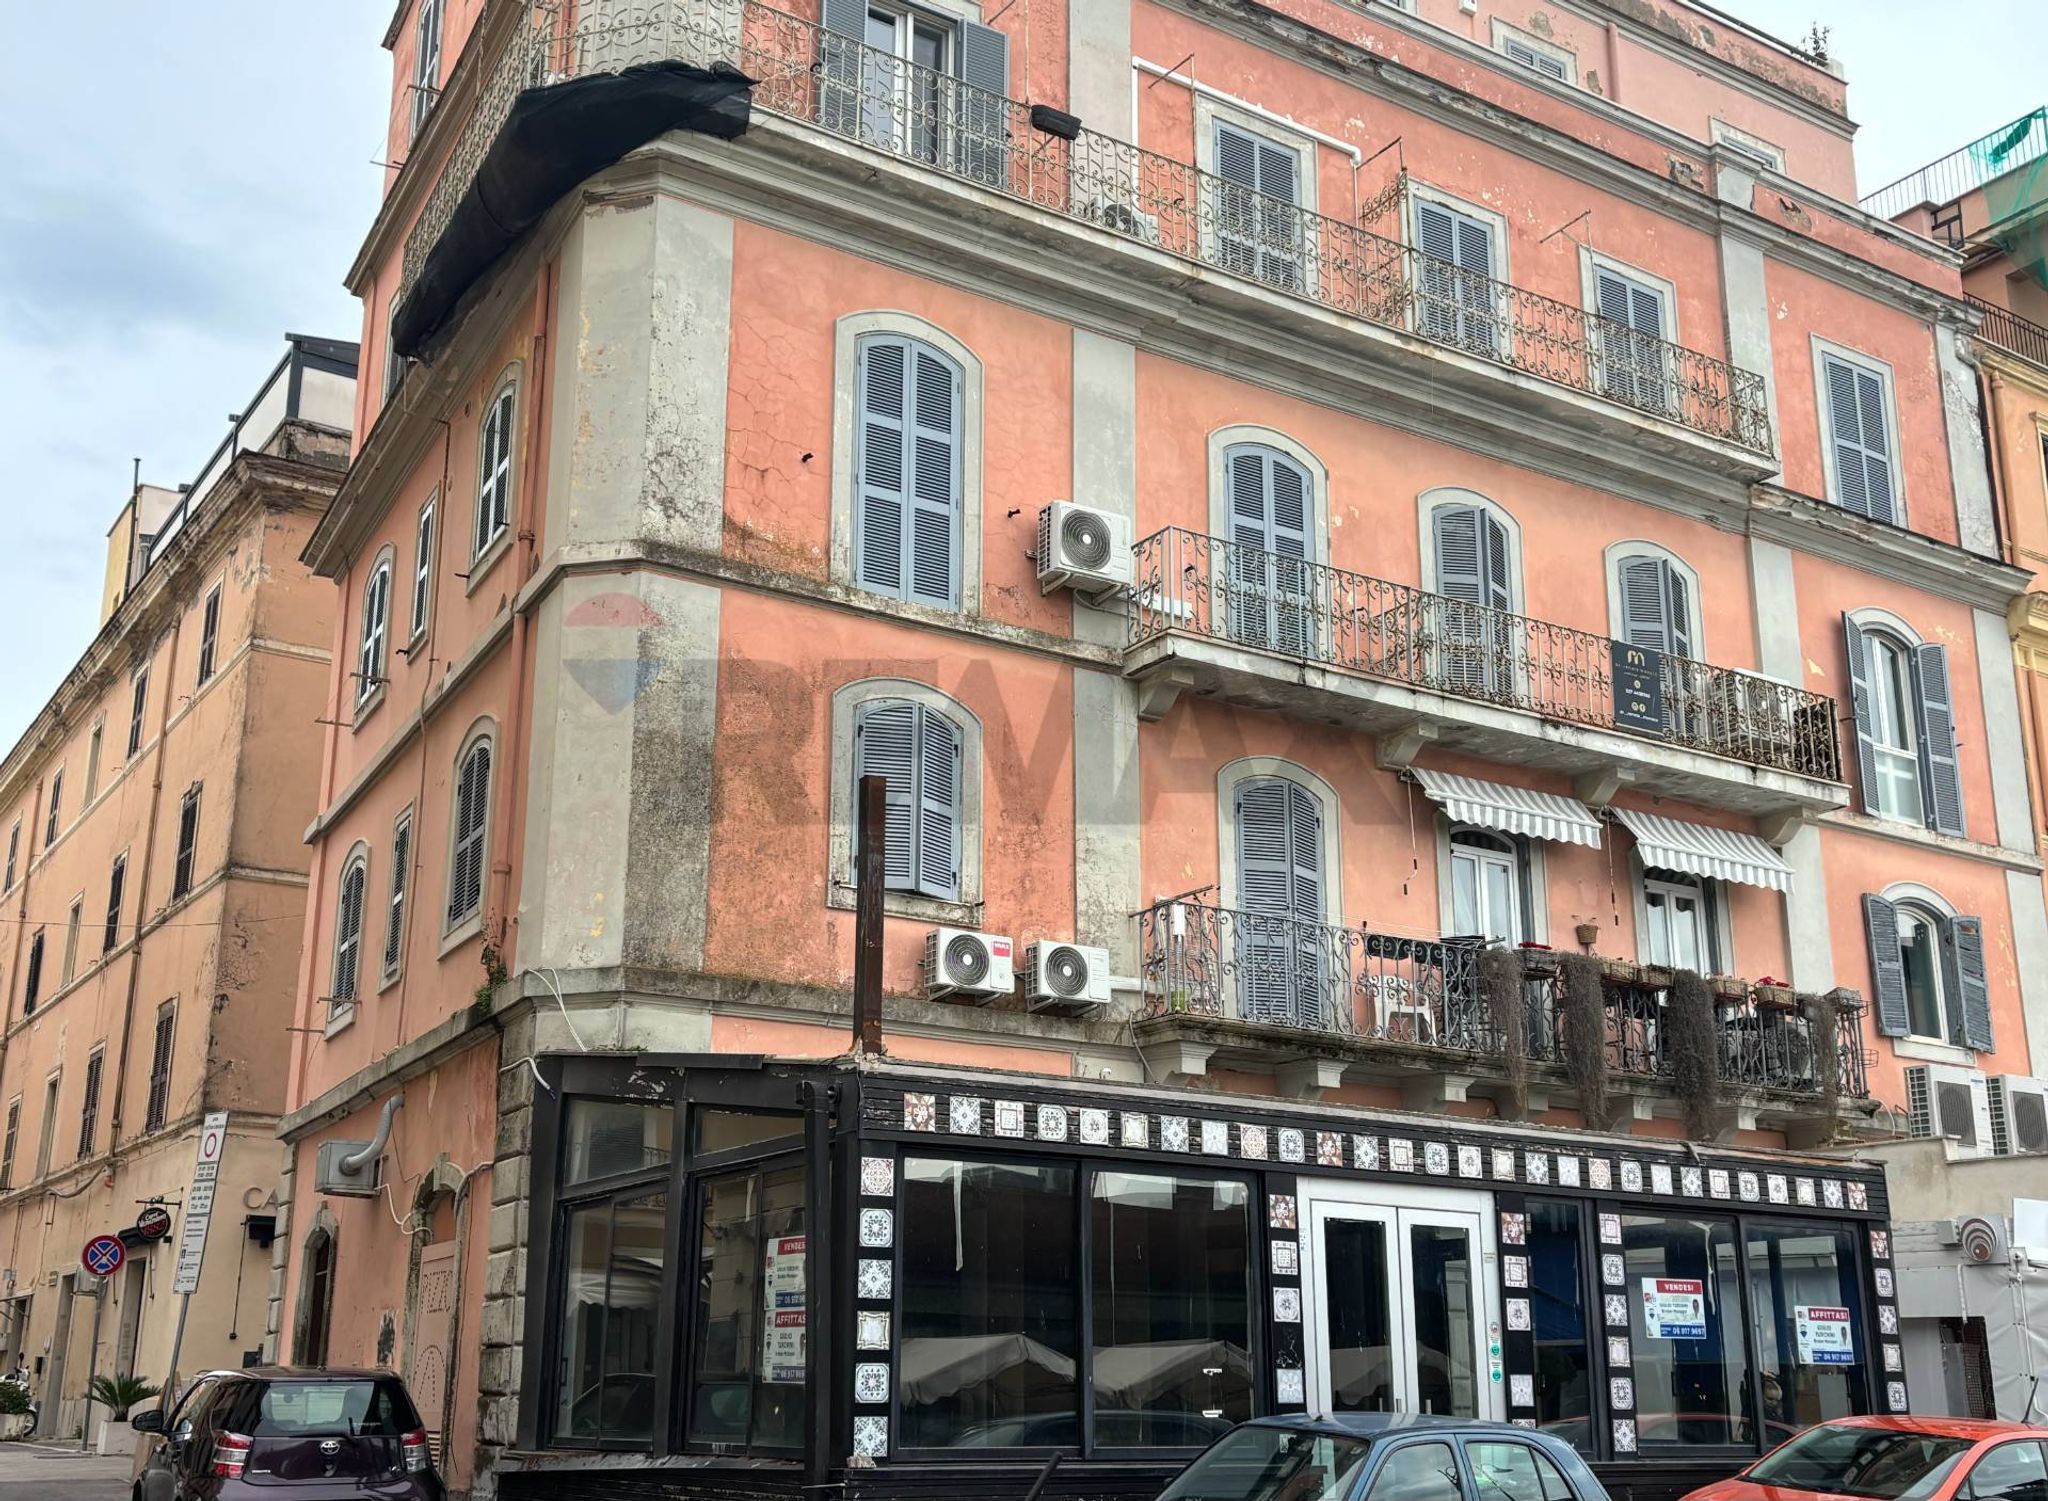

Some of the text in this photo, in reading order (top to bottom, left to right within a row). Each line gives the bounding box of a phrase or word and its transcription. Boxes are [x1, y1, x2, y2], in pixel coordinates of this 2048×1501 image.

[784, 1242, 806, 1251] VENDES
[1664, 1283, 1694, 1291] VENDESI
[776, 1314, 806, 1324] AFFITTAS
[1810, 1311, 1847, 1320] AFFITTASI
